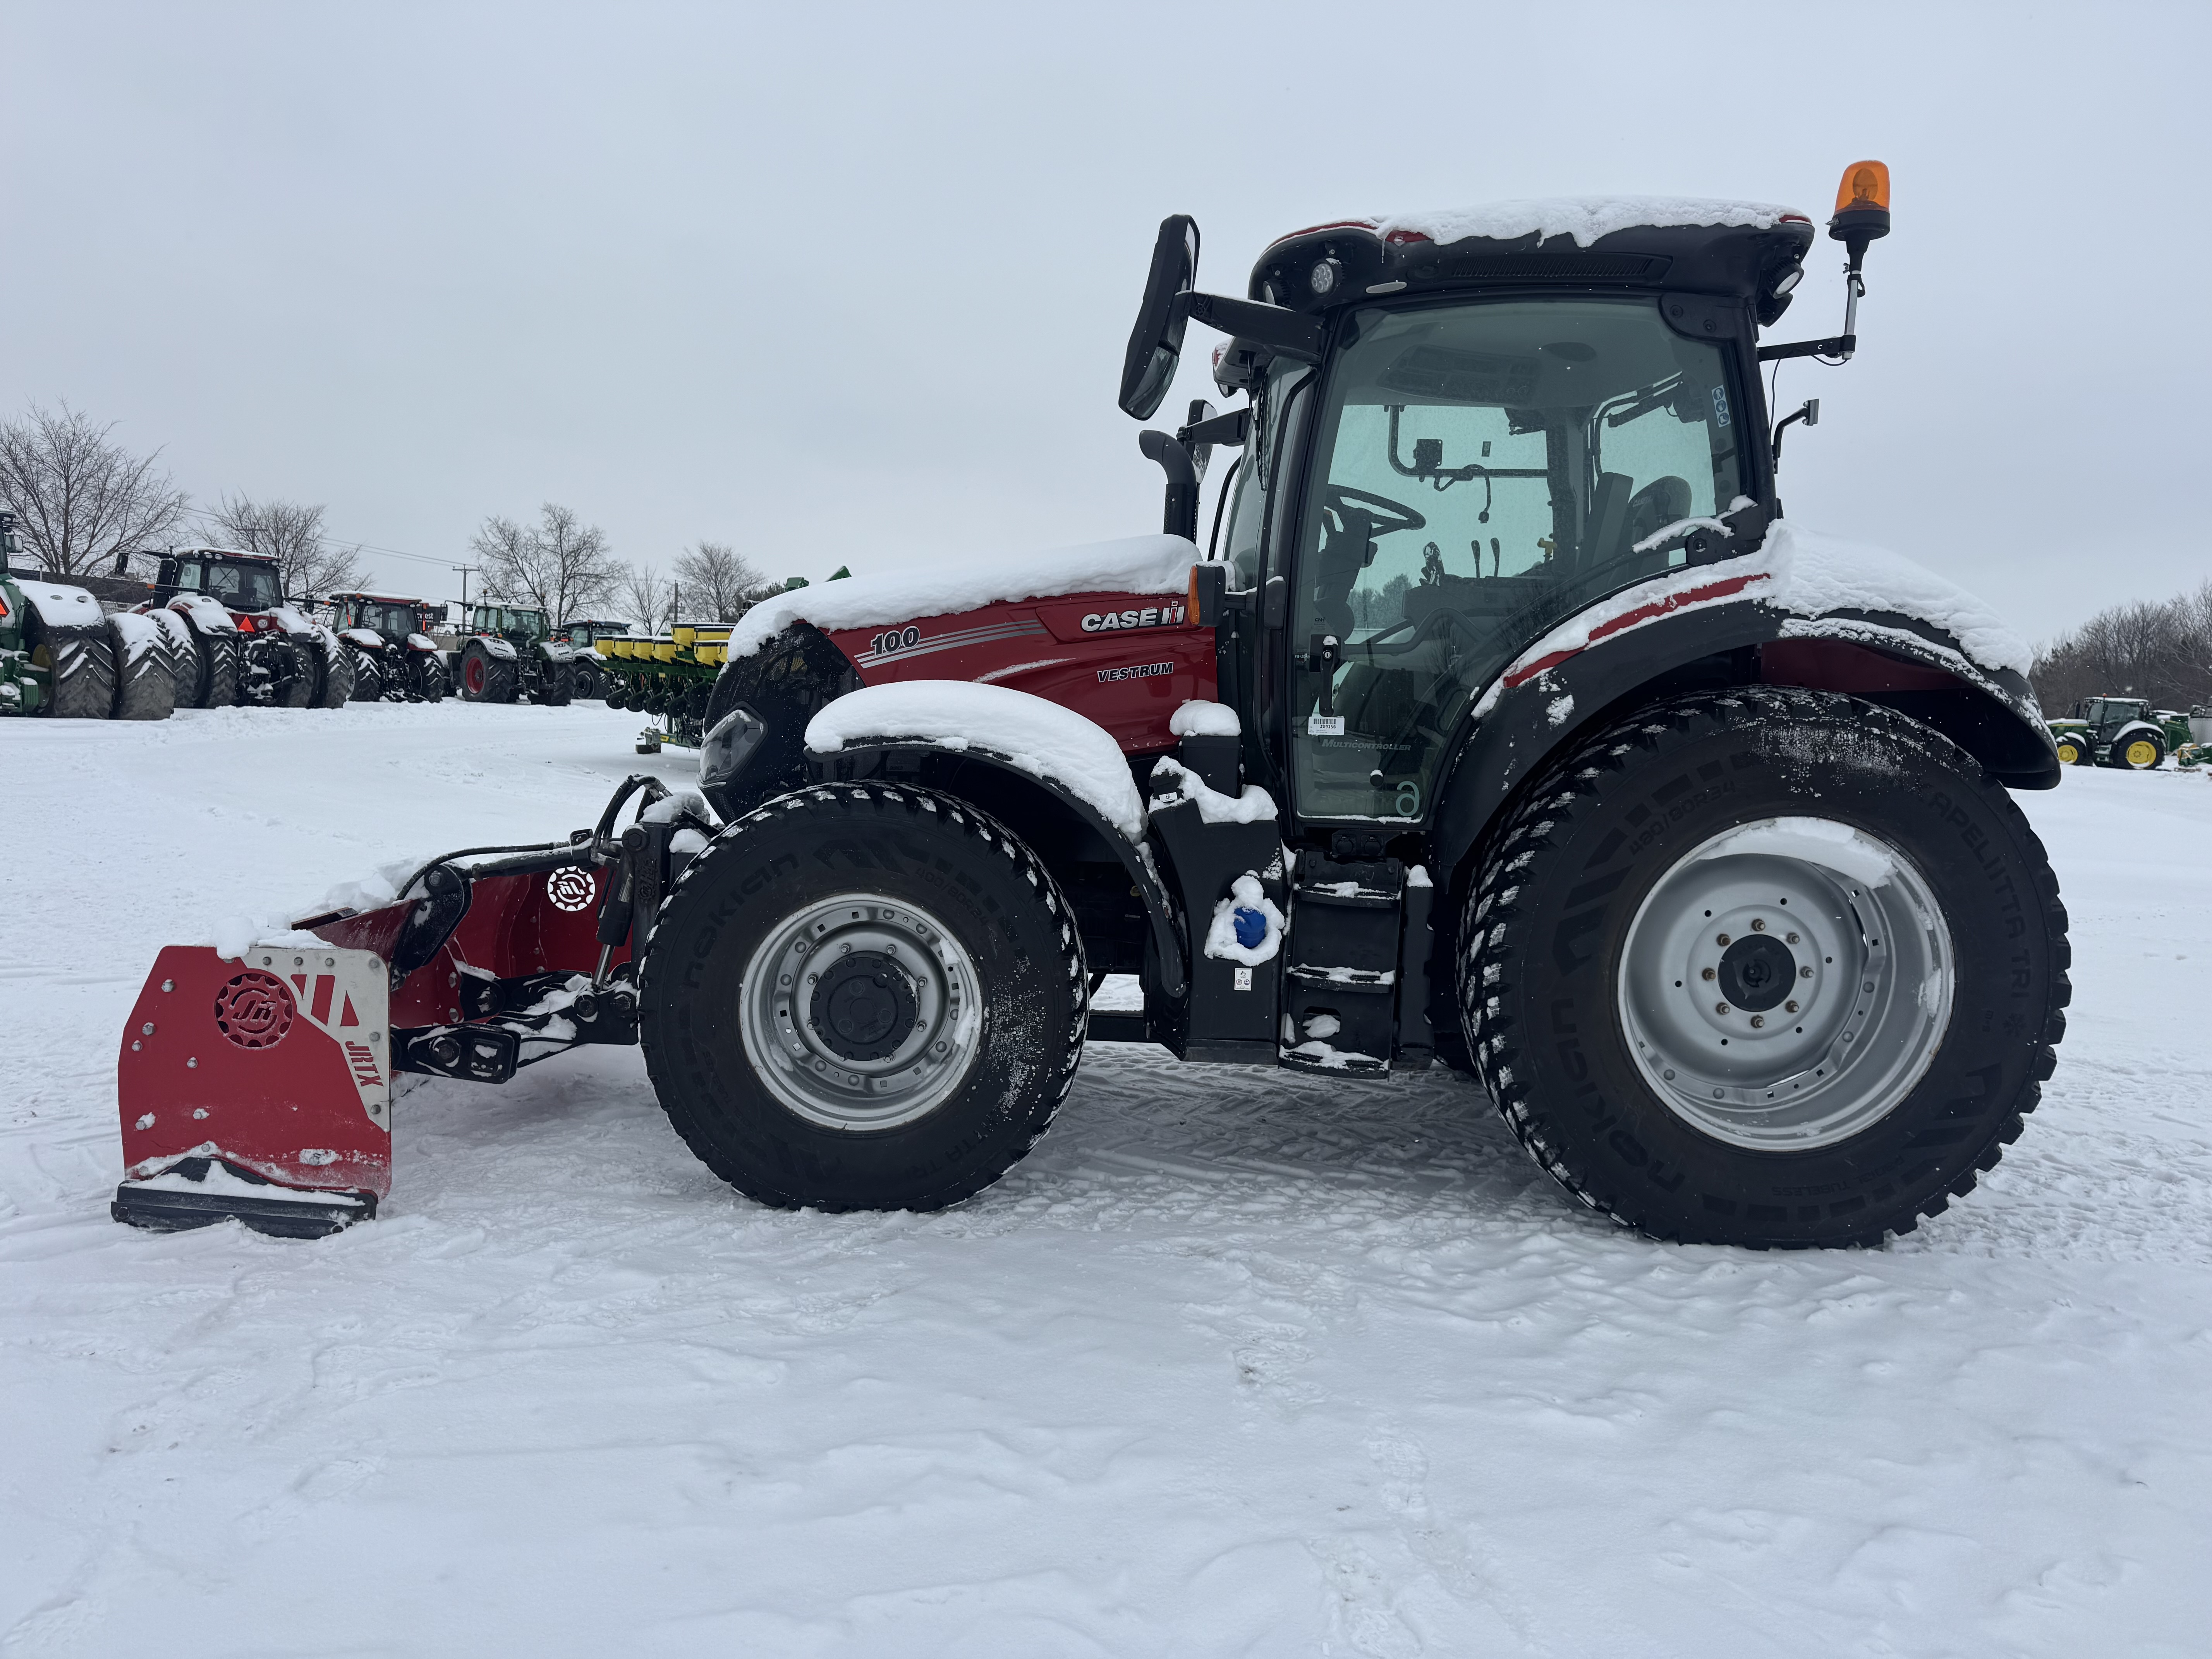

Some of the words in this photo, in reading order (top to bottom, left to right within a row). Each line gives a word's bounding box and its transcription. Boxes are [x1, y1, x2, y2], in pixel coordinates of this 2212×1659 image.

[1081, 608, 1158, 631] CASE
[871, 626, 920, 656] 100
[1097, 661, 1174, 683] VESTRUM
[1629, 780, 1736, 856] 480/80R34
[915, 868, 989, 926] 400/80R24
[2011, 949, 2030, 998] TRI
[345, 1041, 384, 1087] JRTX
[1772, 1181, 1850, 1197] TUBELESS
